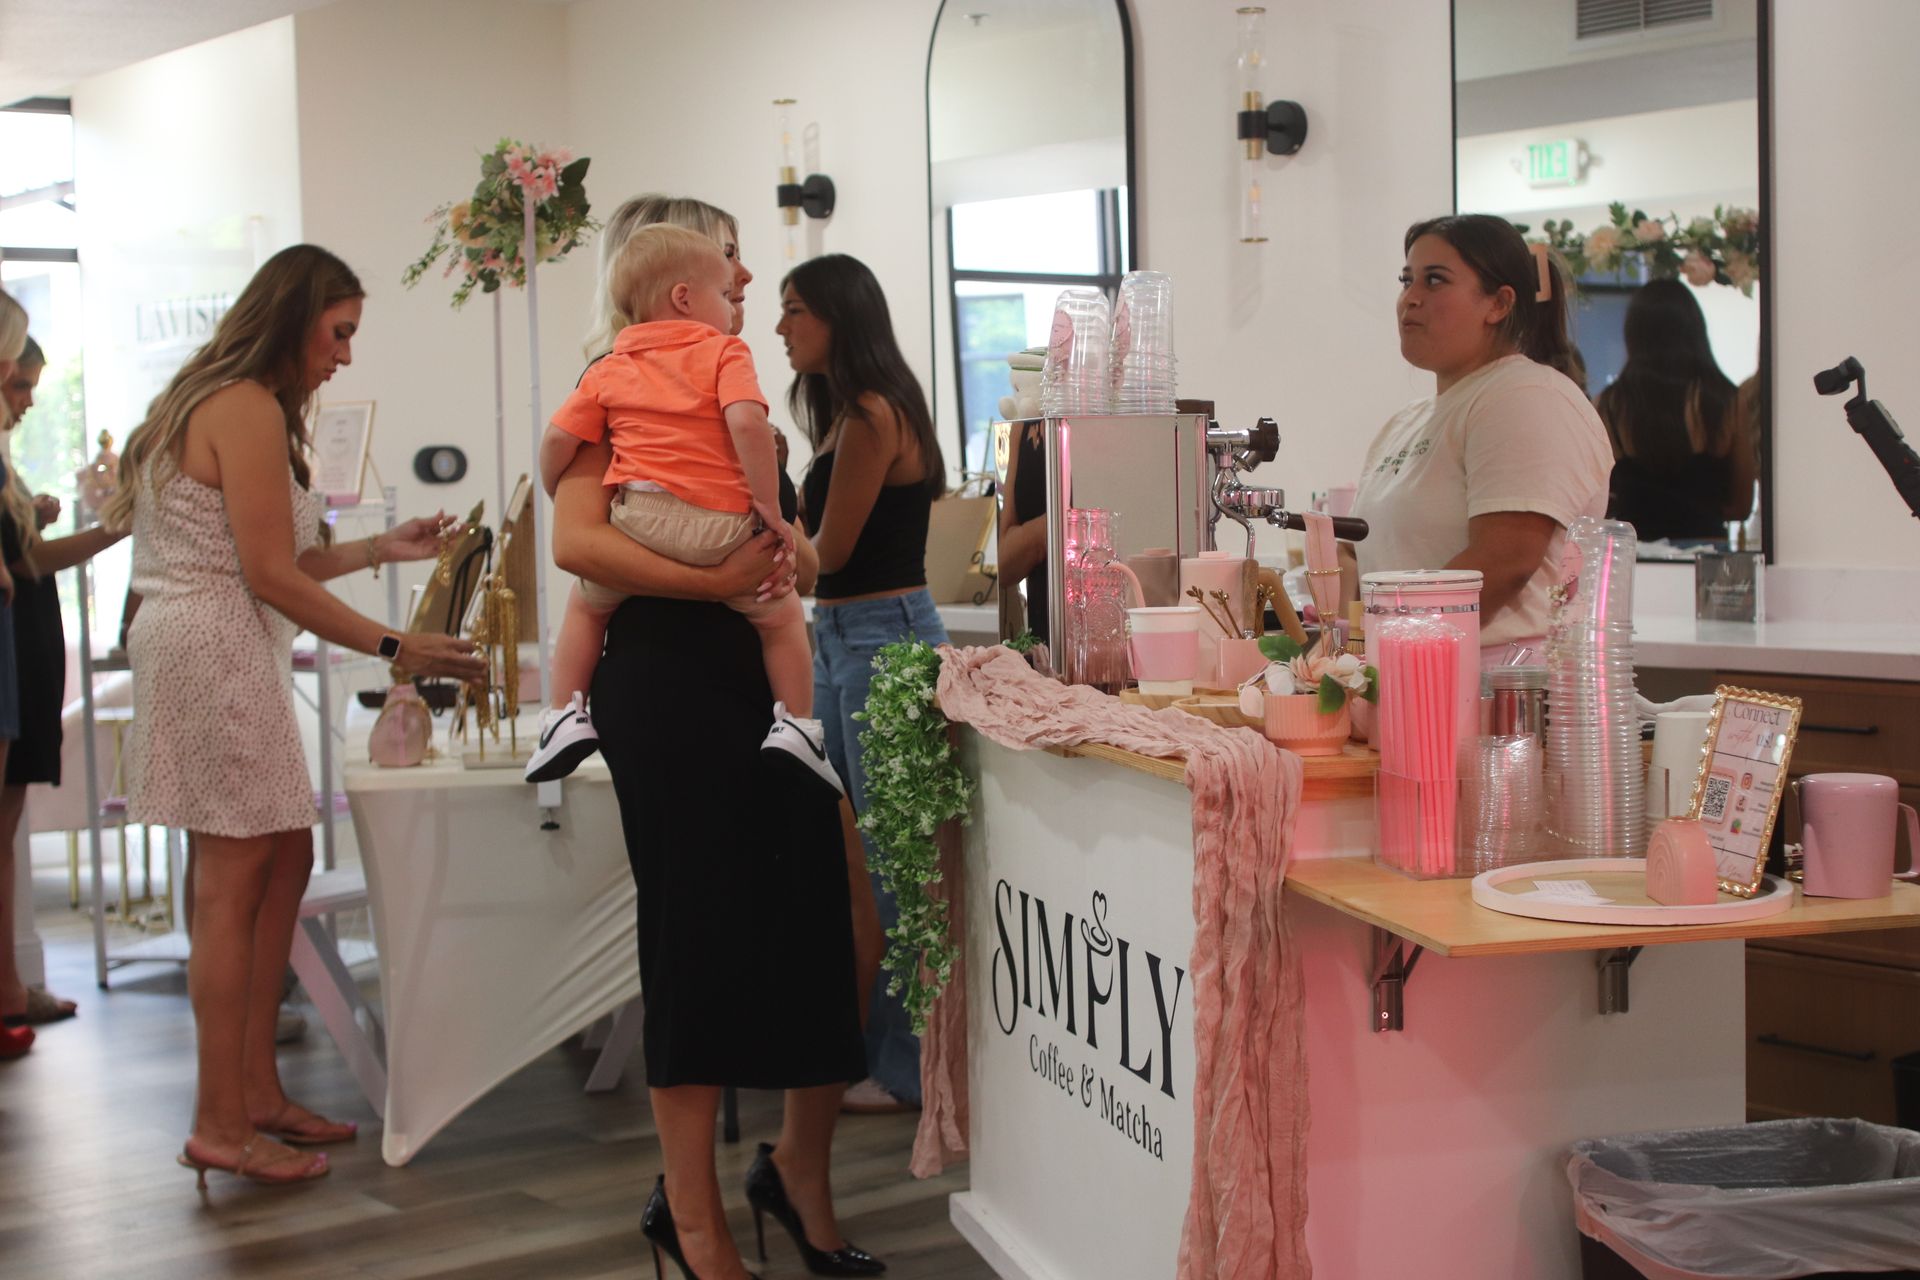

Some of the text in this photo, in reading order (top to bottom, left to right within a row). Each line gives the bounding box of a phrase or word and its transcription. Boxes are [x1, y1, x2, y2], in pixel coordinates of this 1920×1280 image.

[1733, 702, 1781, 726] Connect
[1756, 732, 1774, 749] us!
[992, 879, 1185, 1100] SIMPLY
[1029, 1034, 1163, 1162] Coffee & Matcha
